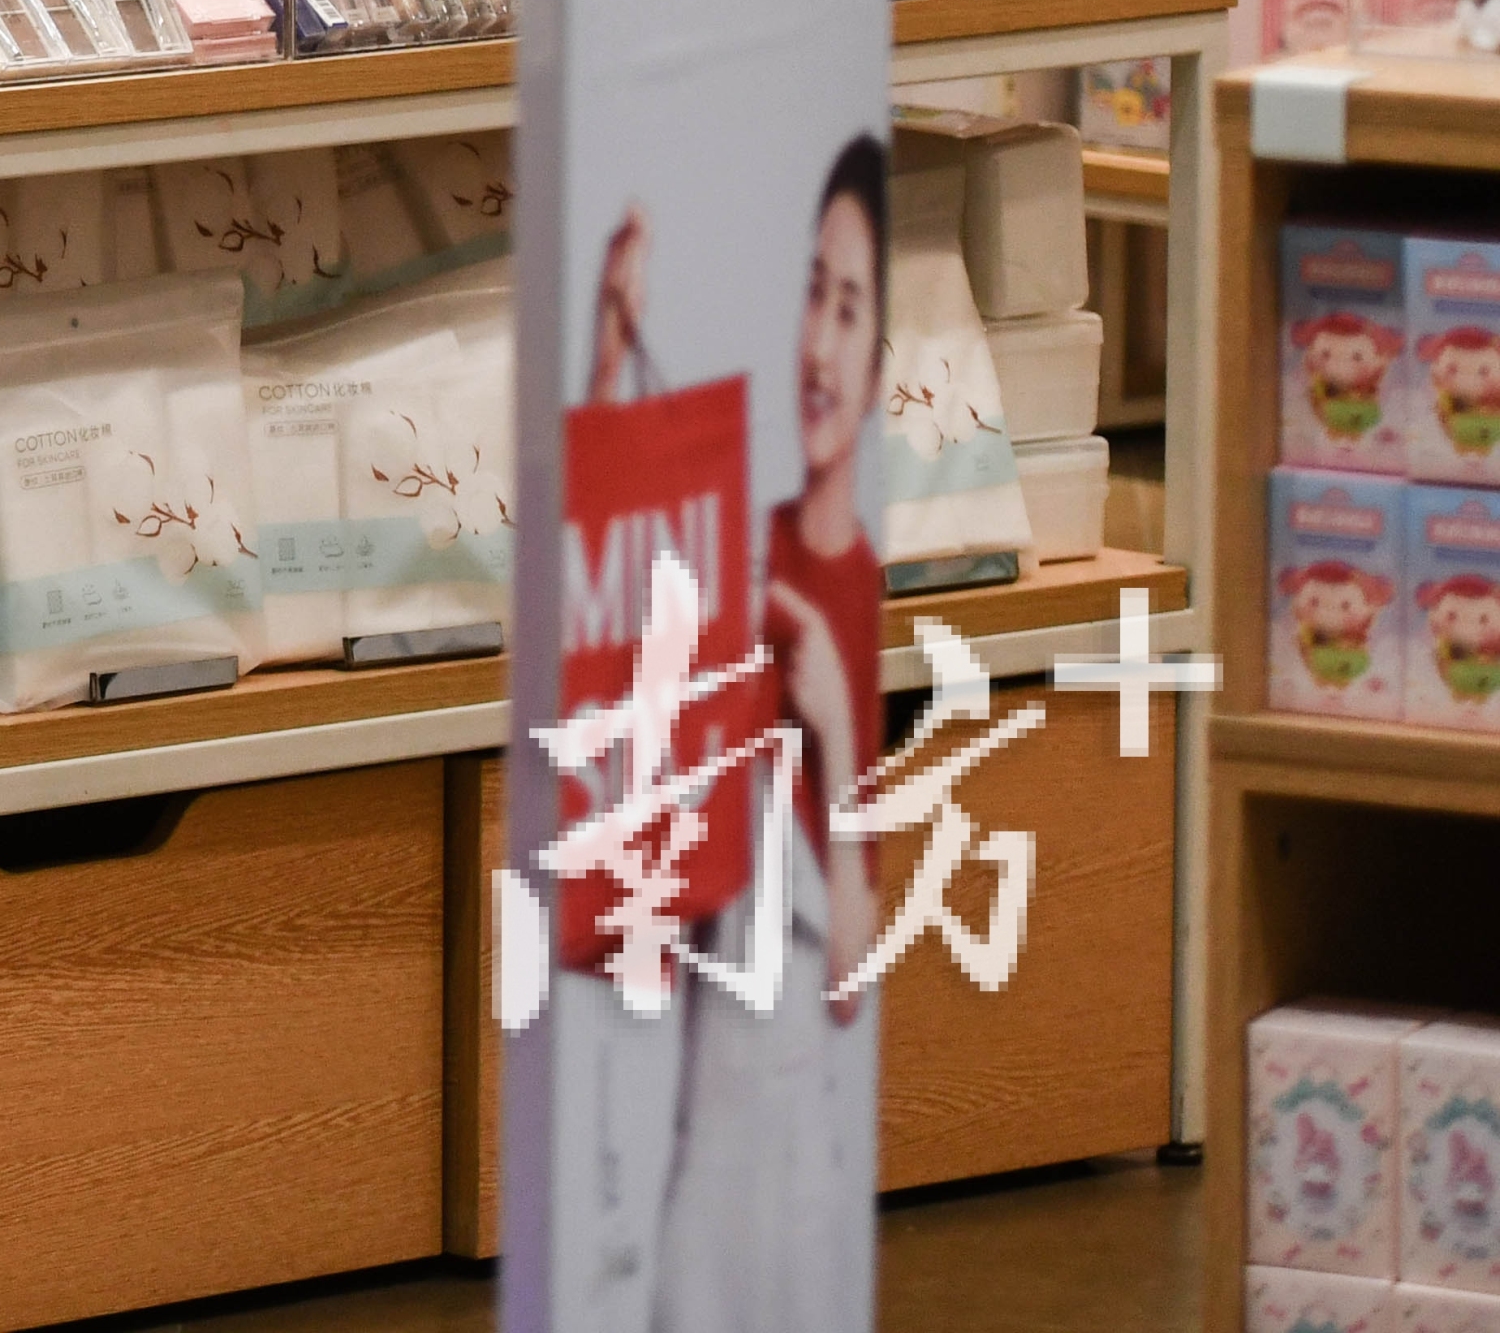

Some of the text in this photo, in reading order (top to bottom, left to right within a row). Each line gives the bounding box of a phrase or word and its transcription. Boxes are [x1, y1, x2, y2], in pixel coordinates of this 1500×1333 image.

[258, 382, 331, 402] COTTON
[14, 429, 78, 454] COTTON
[40, 449, 81, 465] SKINCARE
